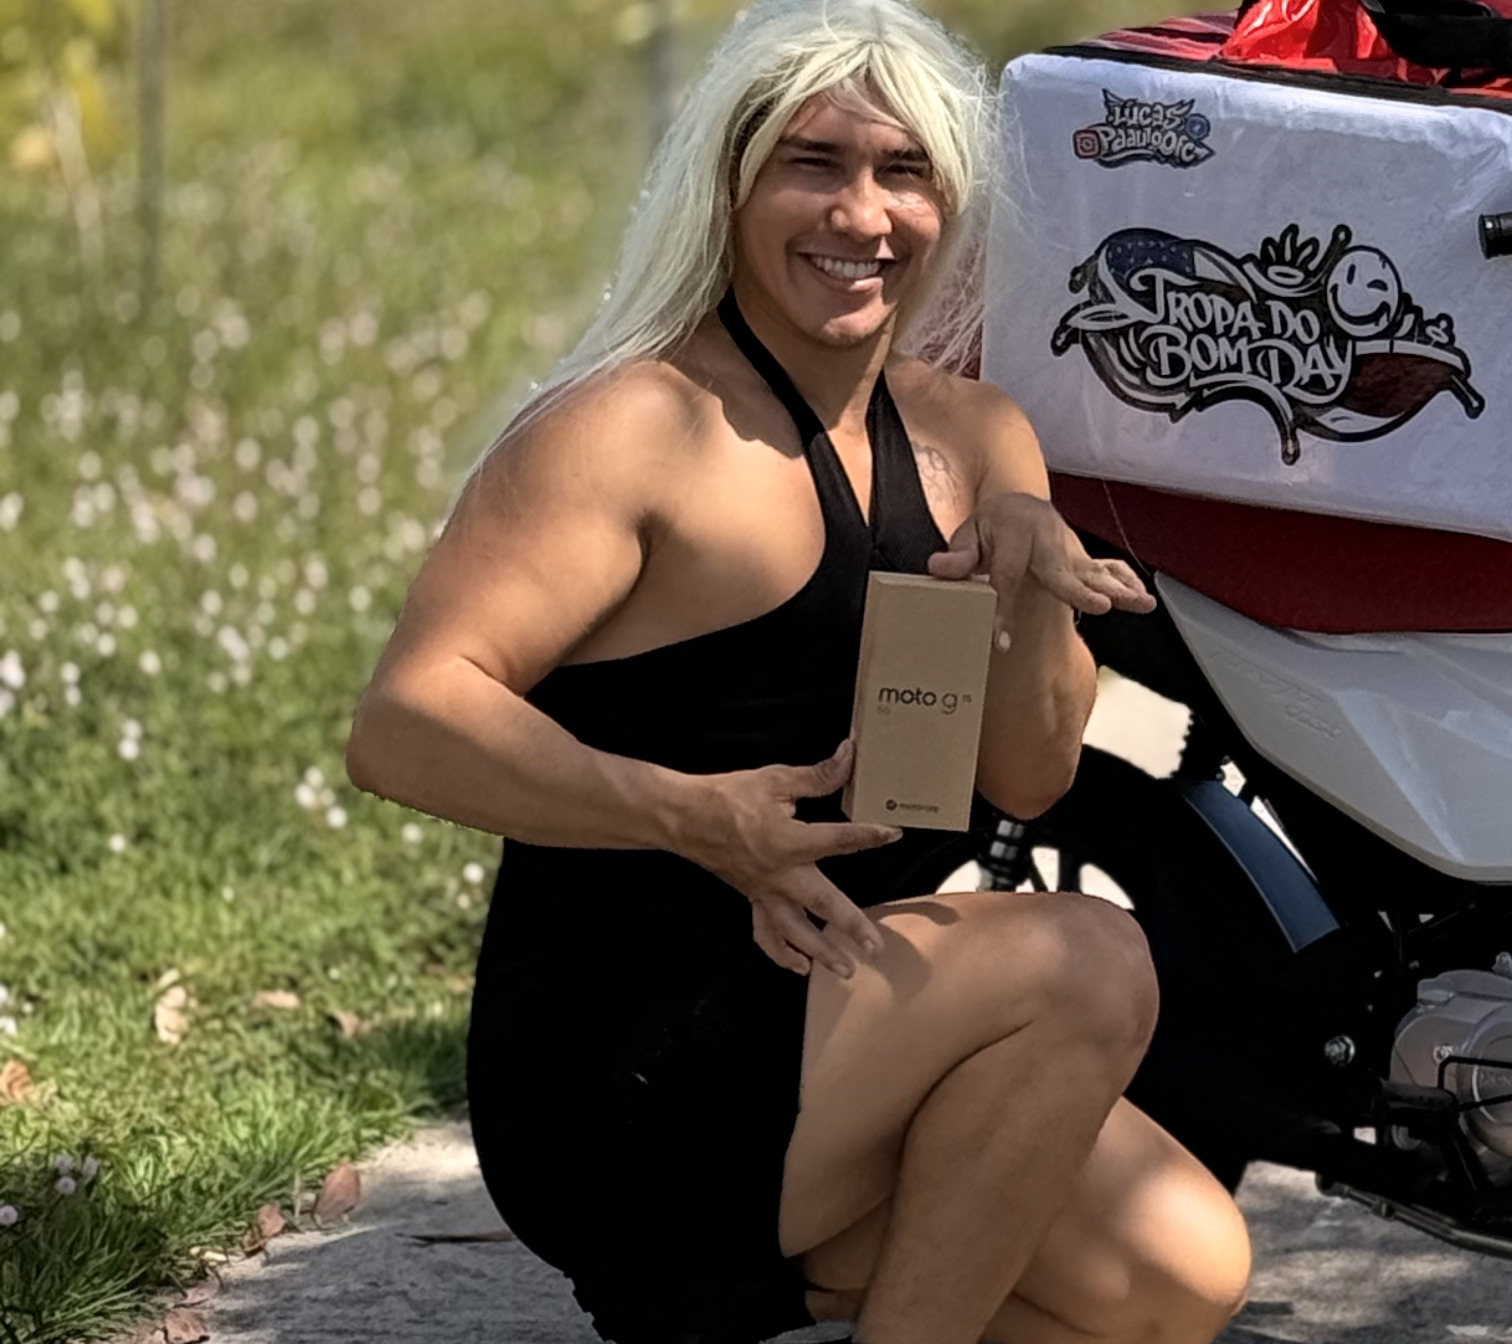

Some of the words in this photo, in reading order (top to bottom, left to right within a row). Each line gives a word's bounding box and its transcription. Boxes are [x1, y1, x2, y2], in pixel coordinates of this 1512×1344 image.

[1130, 267, 1267, 340] TROPA
[1265, 299, 1321, 345] DO
[1140, 324, 1250, 387] BOM
[879, 687, 937, 707] moto
[942, 692, 958, 715] g
